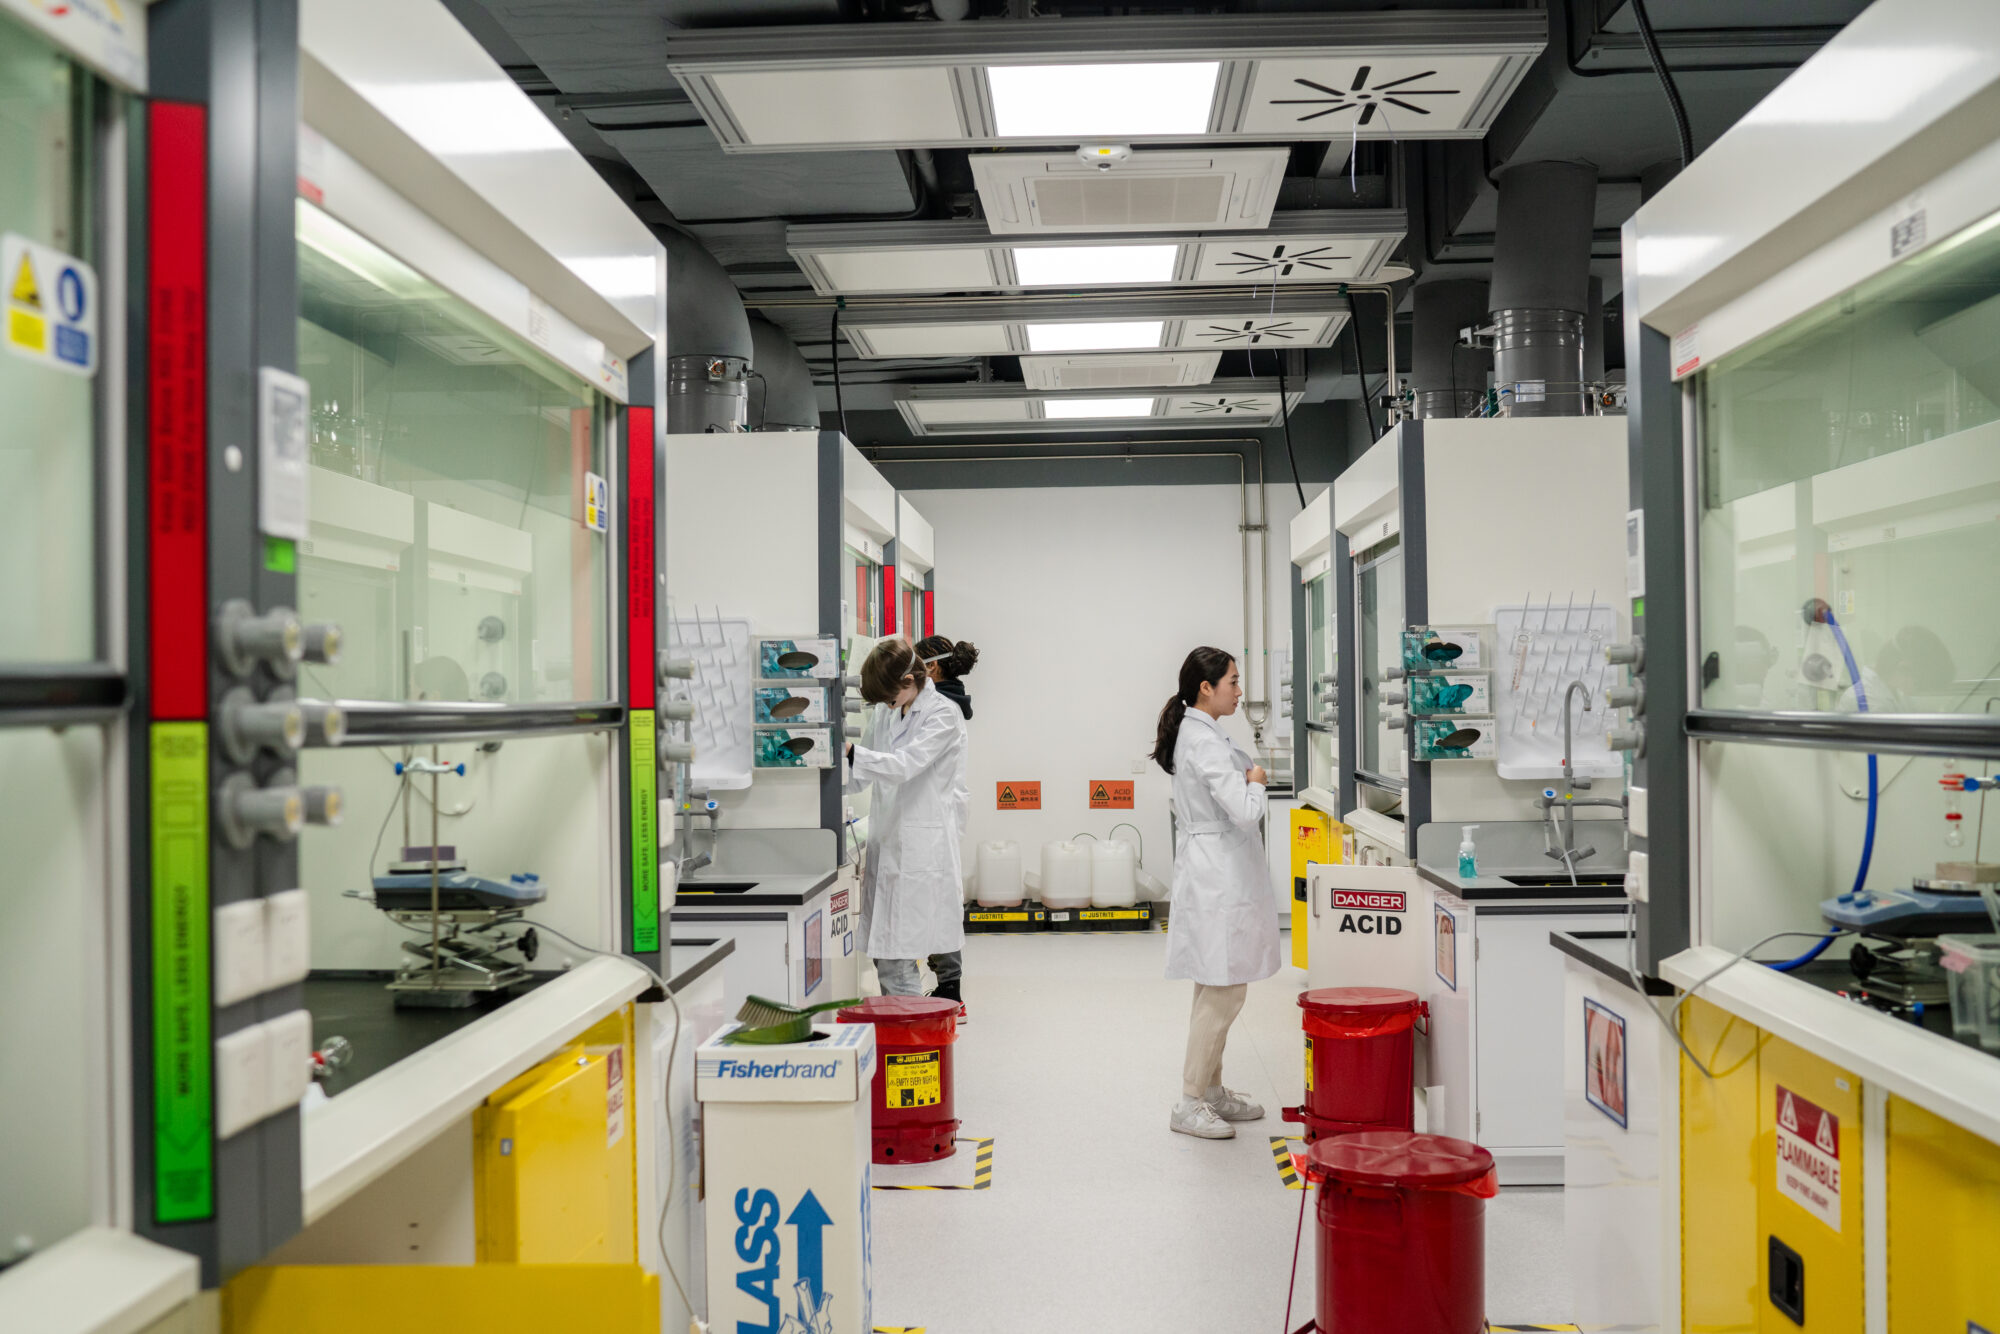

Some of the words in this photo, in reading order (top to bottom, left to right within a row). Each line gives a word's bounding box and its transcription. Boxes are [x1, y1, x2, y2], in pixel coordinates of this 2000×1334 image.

[640, 789, 648, 821] ENERGY
[1335, 893, 1402, 908] DANGER
[831, 914, 848, 938] ACID
[1339, 913, 1402, 935] ACID
[904, 1054, 931, 1063] JUSTRITE
[896, 1077, 910, 1087] EMPTY
[910, 1076, 922, 1087] EVERY
[1777, 1135, 1838, 1194] FLAMMABLE
